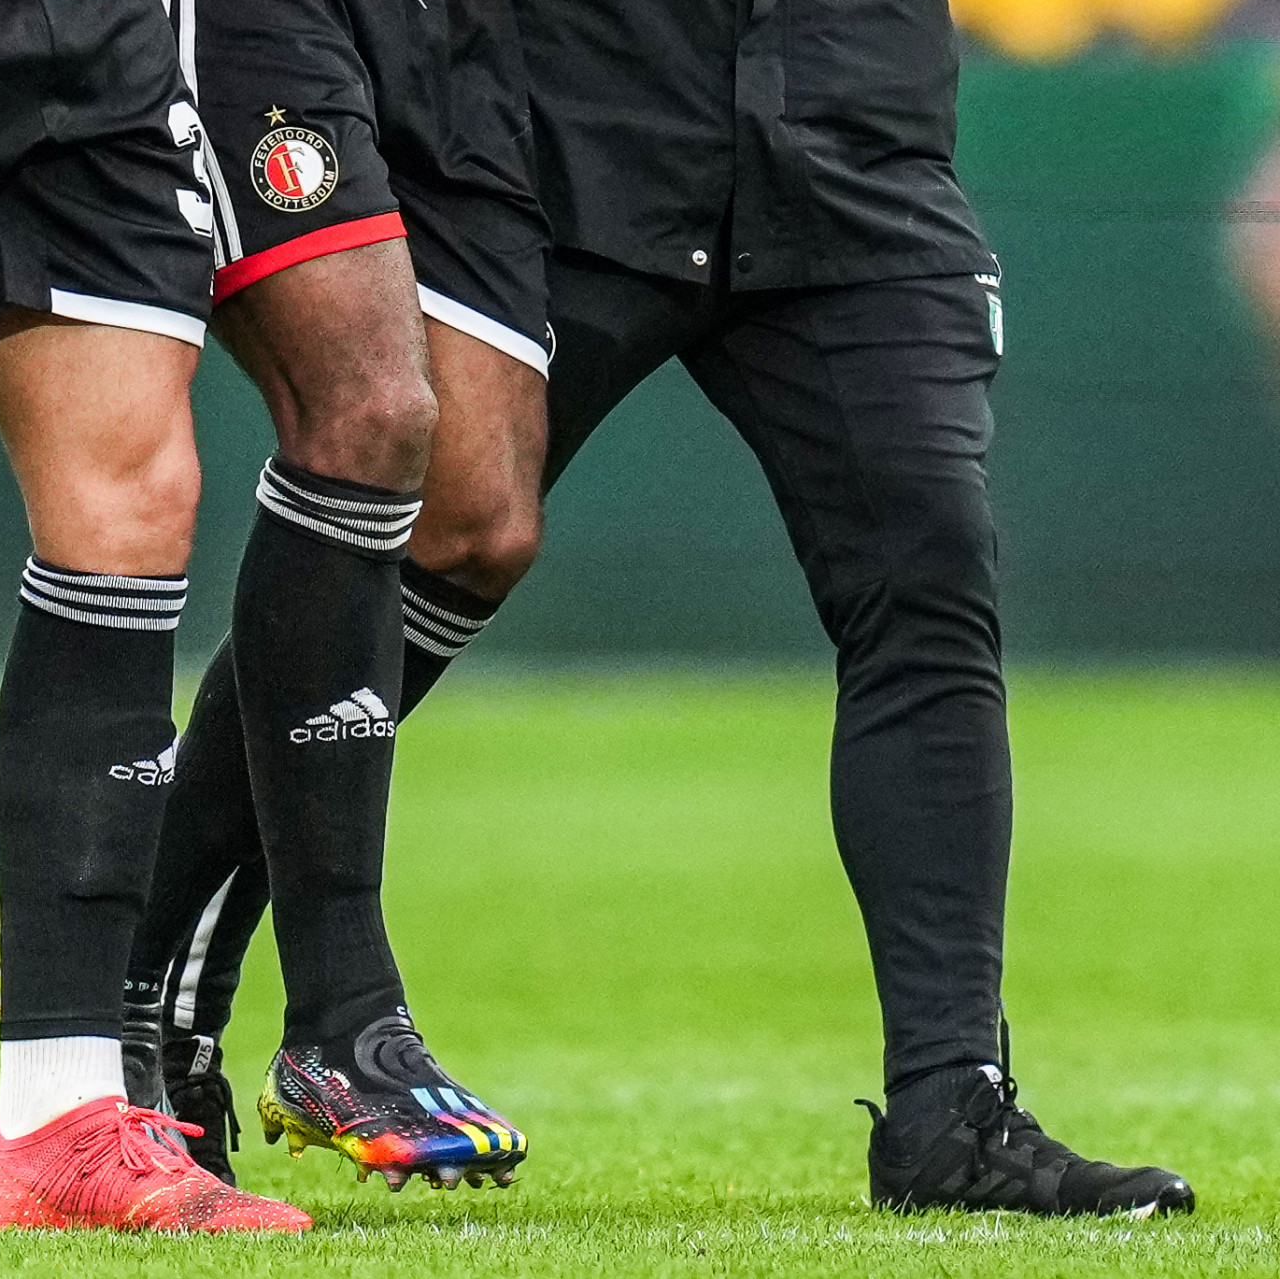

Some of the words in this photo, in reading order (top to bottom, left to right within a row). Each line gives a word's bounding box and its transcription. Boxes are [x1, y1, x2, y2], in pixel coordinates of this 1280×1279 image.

[255, 130, 323, 168] FEYENOORD
[264, 170, 335, 209] ROTTERDAM
[290, 716, 395, 744] adidas
[194, 1044, 213, 1070] 275
